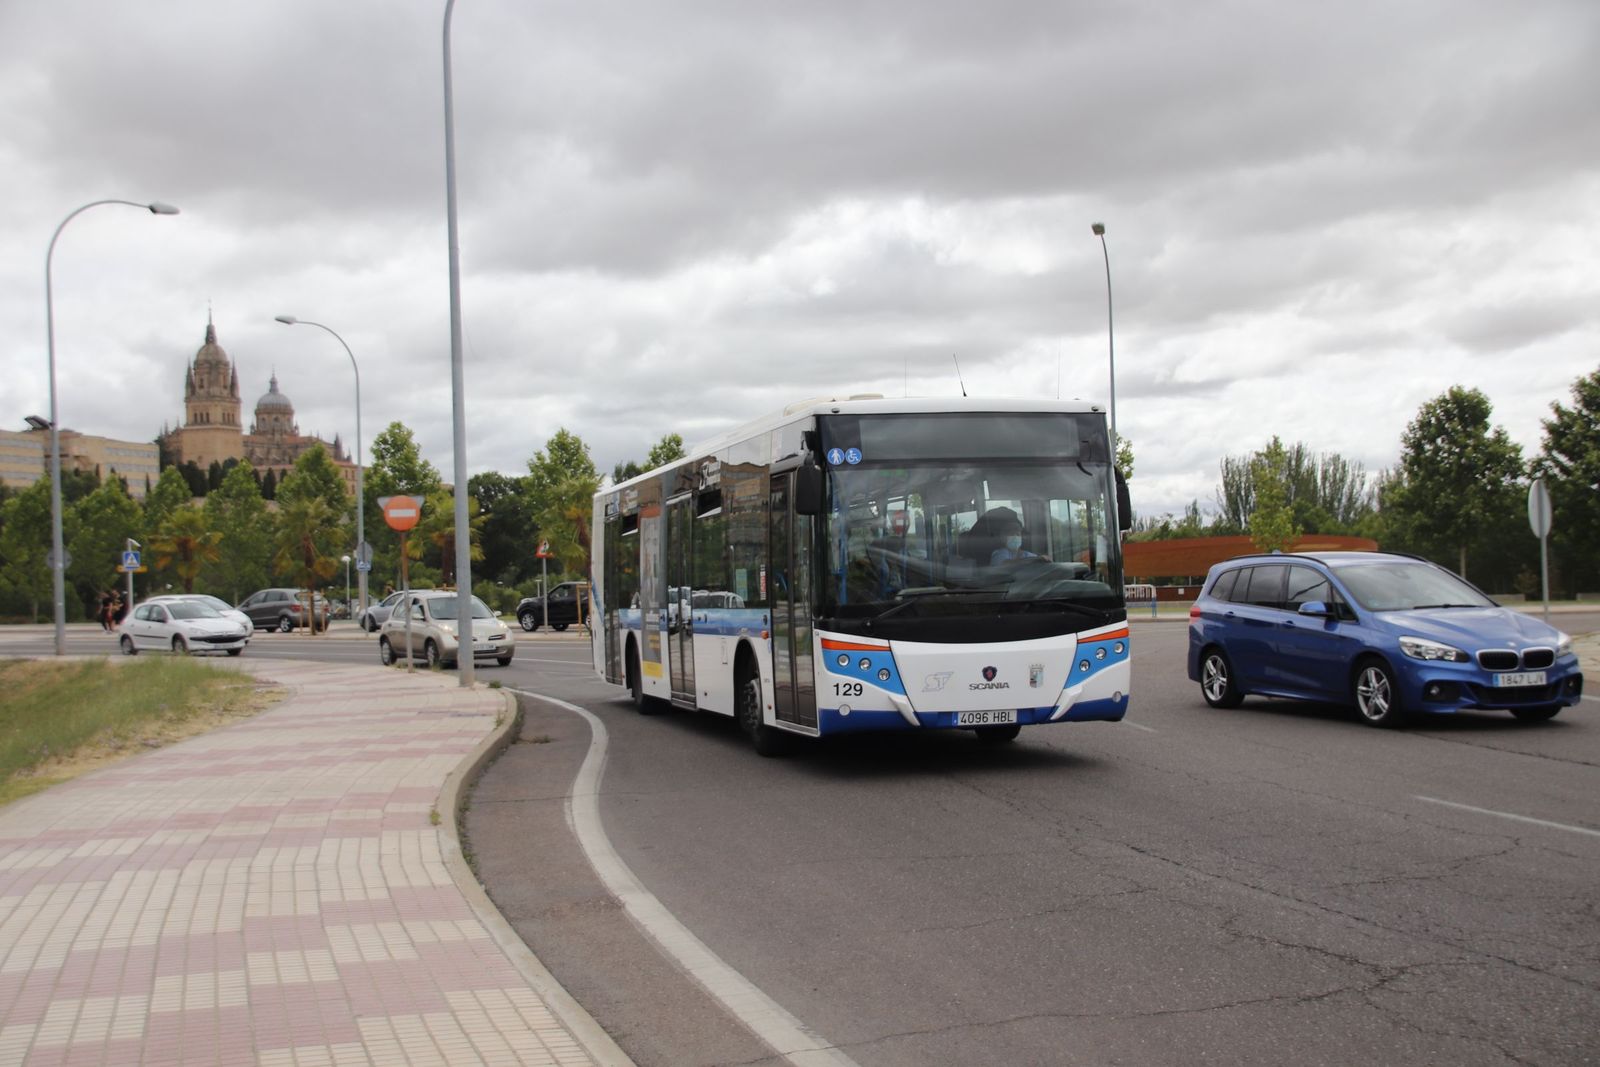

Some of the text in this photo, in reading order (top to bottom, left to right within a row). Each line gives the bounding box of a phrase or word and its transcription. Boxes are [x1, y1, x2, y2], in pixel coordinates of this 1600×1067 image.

[1501, 674, 1524, 685] 1847
[833, 682, 863, 697] 129
[969, 682, 1010, 691] SCANIA
[960, 711, 1014, 724] 4096 HBL
